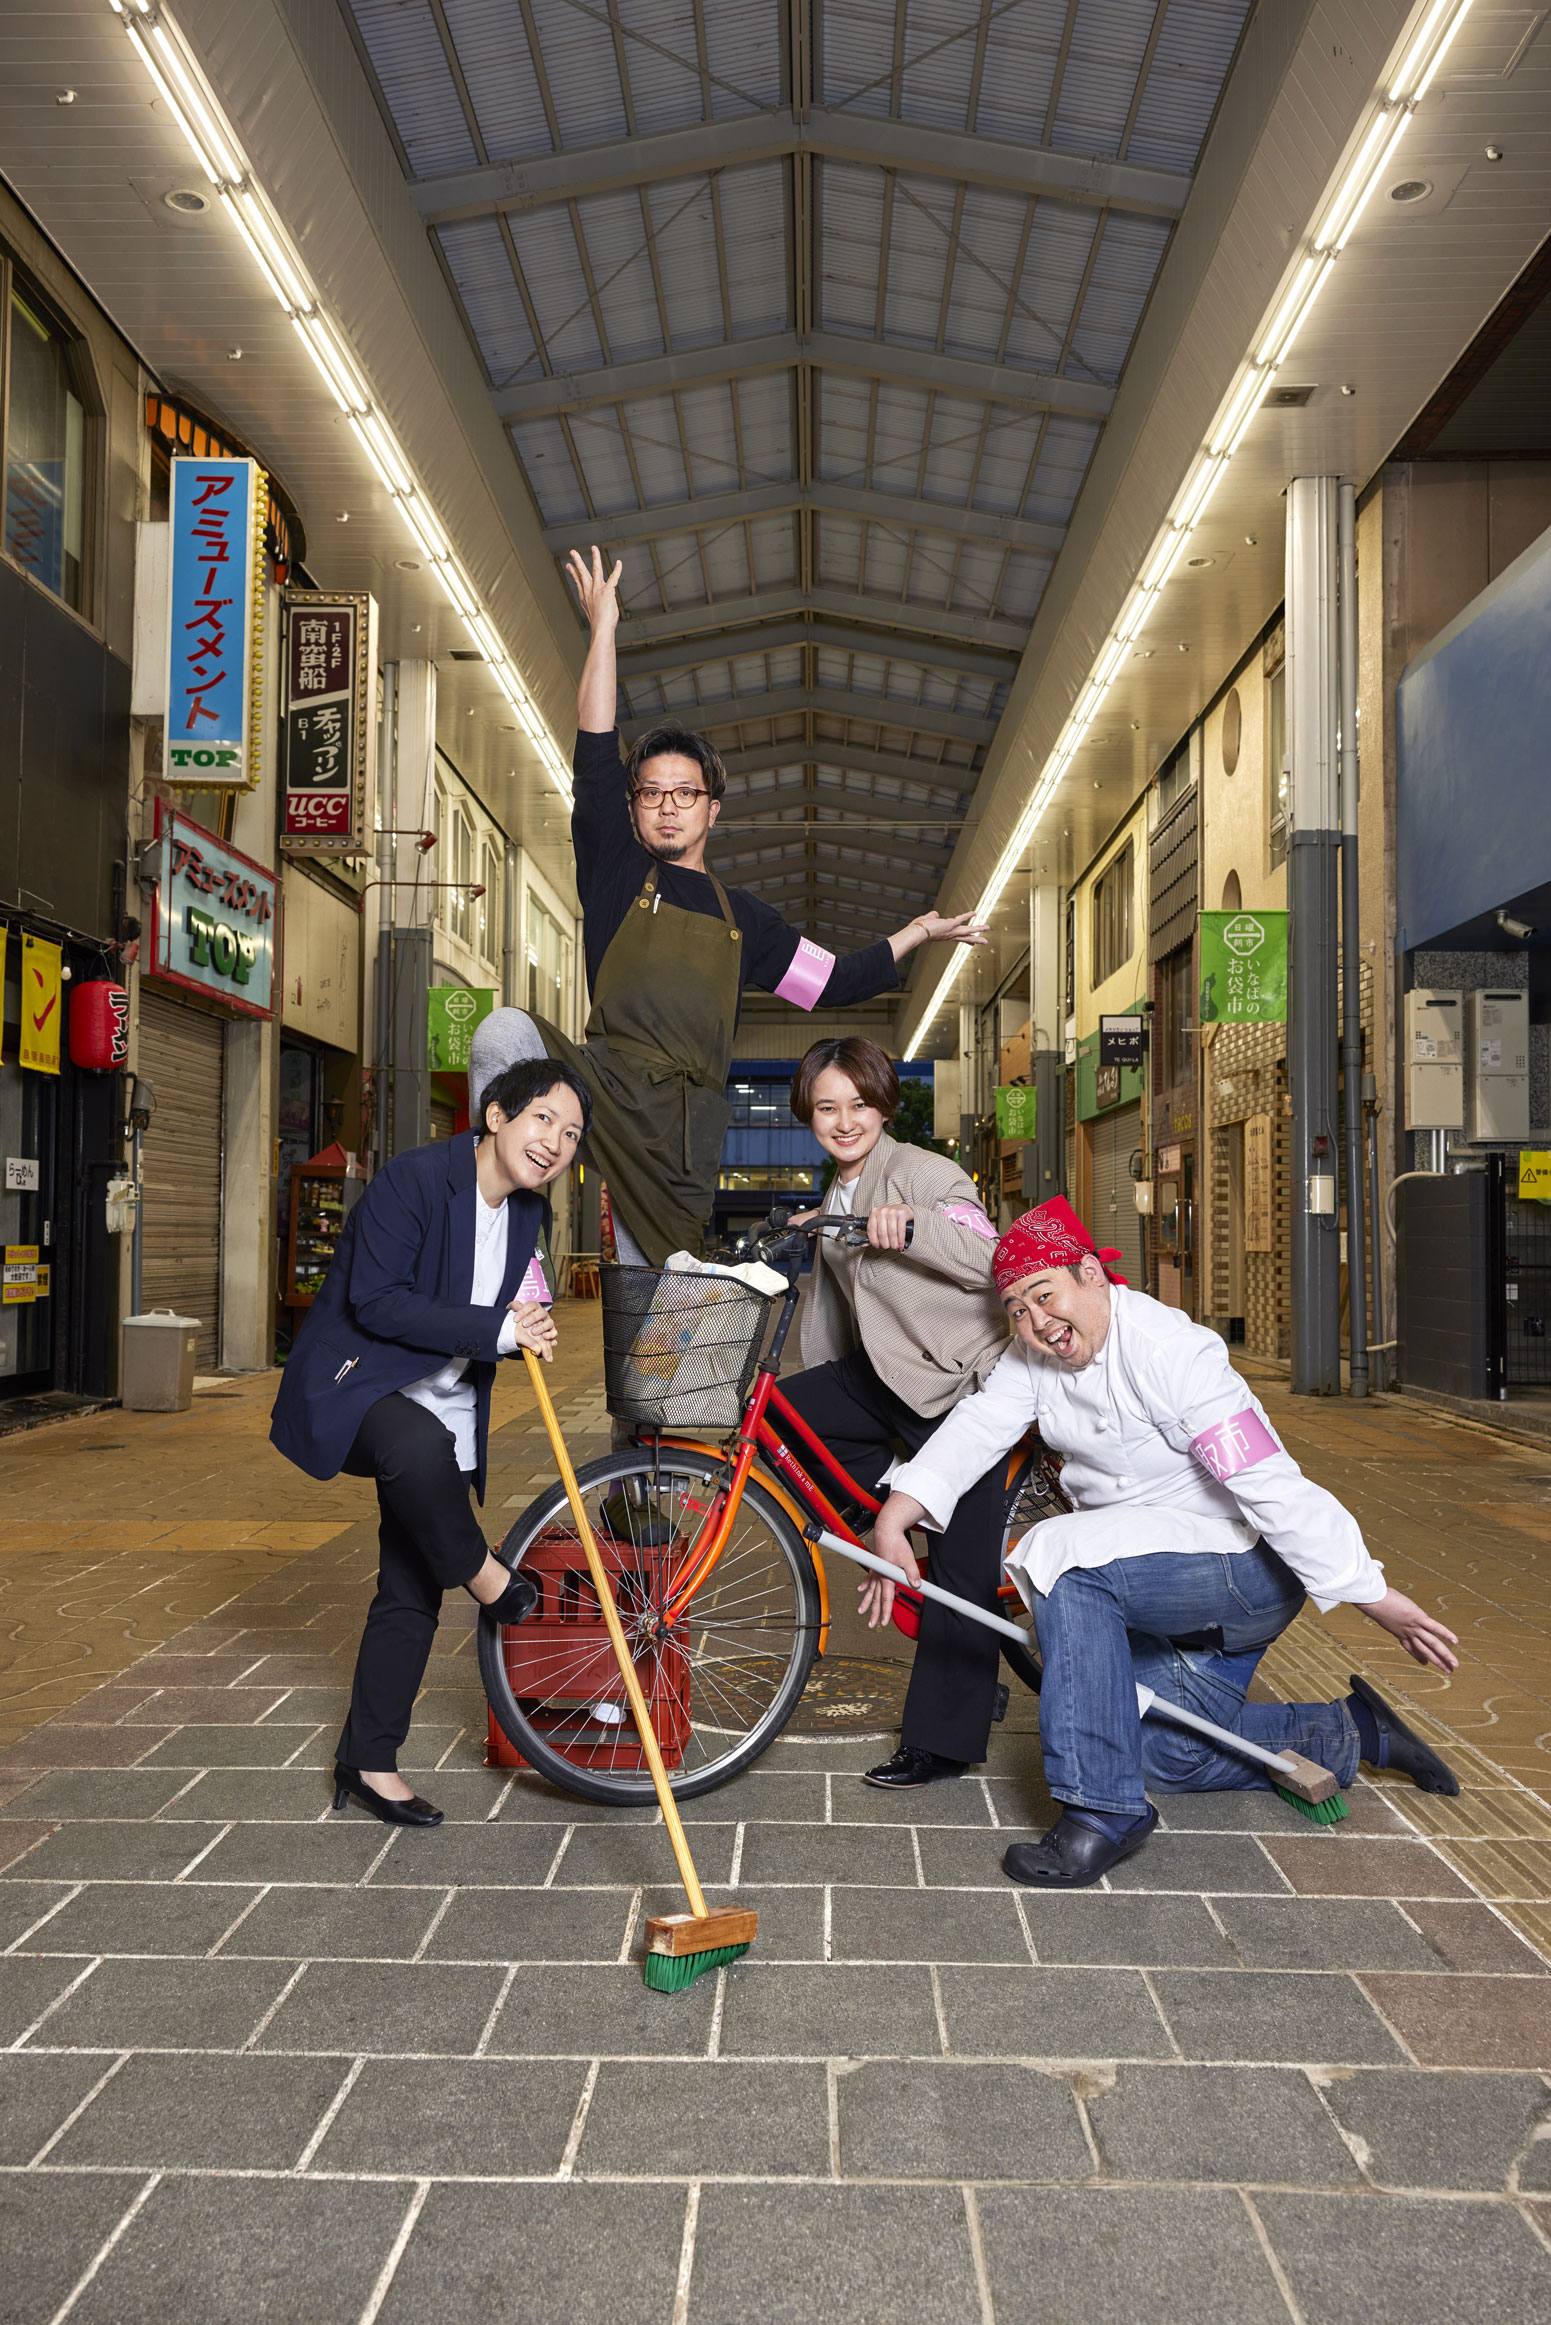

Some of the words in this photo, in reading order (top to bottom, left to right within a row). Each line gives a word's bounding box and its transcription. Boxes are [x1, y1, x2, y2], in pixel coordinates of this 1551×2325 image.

[184, 475, 235, 730] アミューズメント
[170, 749, 238, 767] TOP
[312, 707, 343, 782] チャップリン
[294, 817, 337, 827] コーヒー
[187, 906, 256, 985] TOP
[1227, 958, 1243, 1014] お袋市
[1246, 960, 1260, 1014] いなばの
[448, 1023, 461, 1065] お袋市
